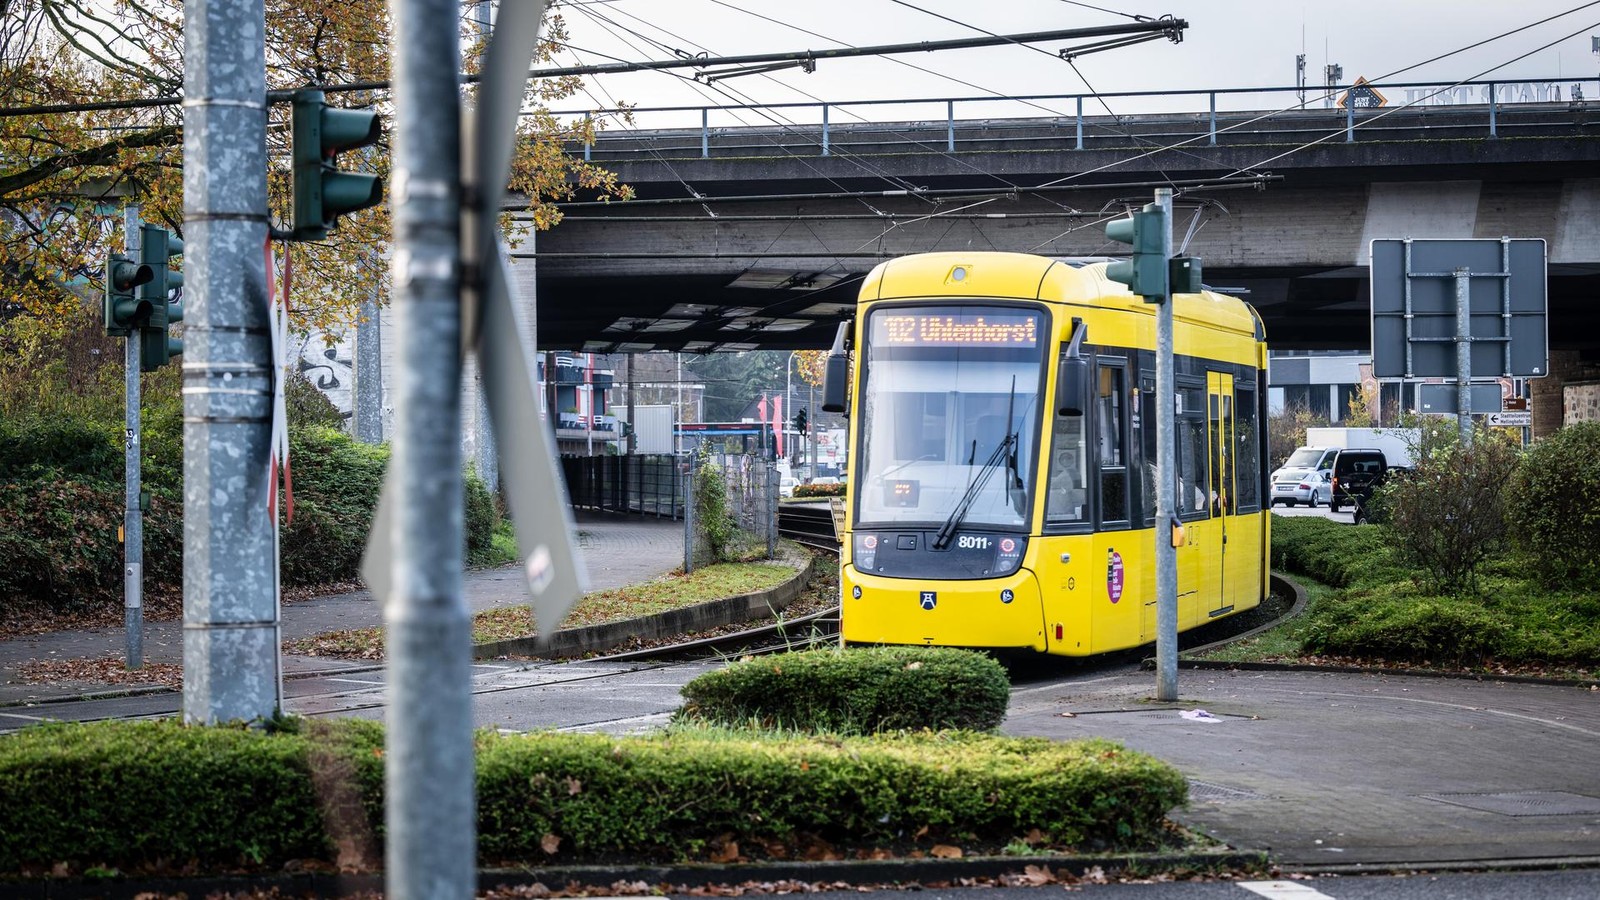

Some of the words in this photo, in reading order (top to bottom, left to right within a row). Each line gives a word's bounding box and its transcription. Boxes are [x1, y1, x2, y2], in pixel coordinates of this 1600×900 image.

[883, 317, 915, 342] 102
[920, 317, 1036, 342] Uhlenhorst
[958, 536, 987, 549] 8011
